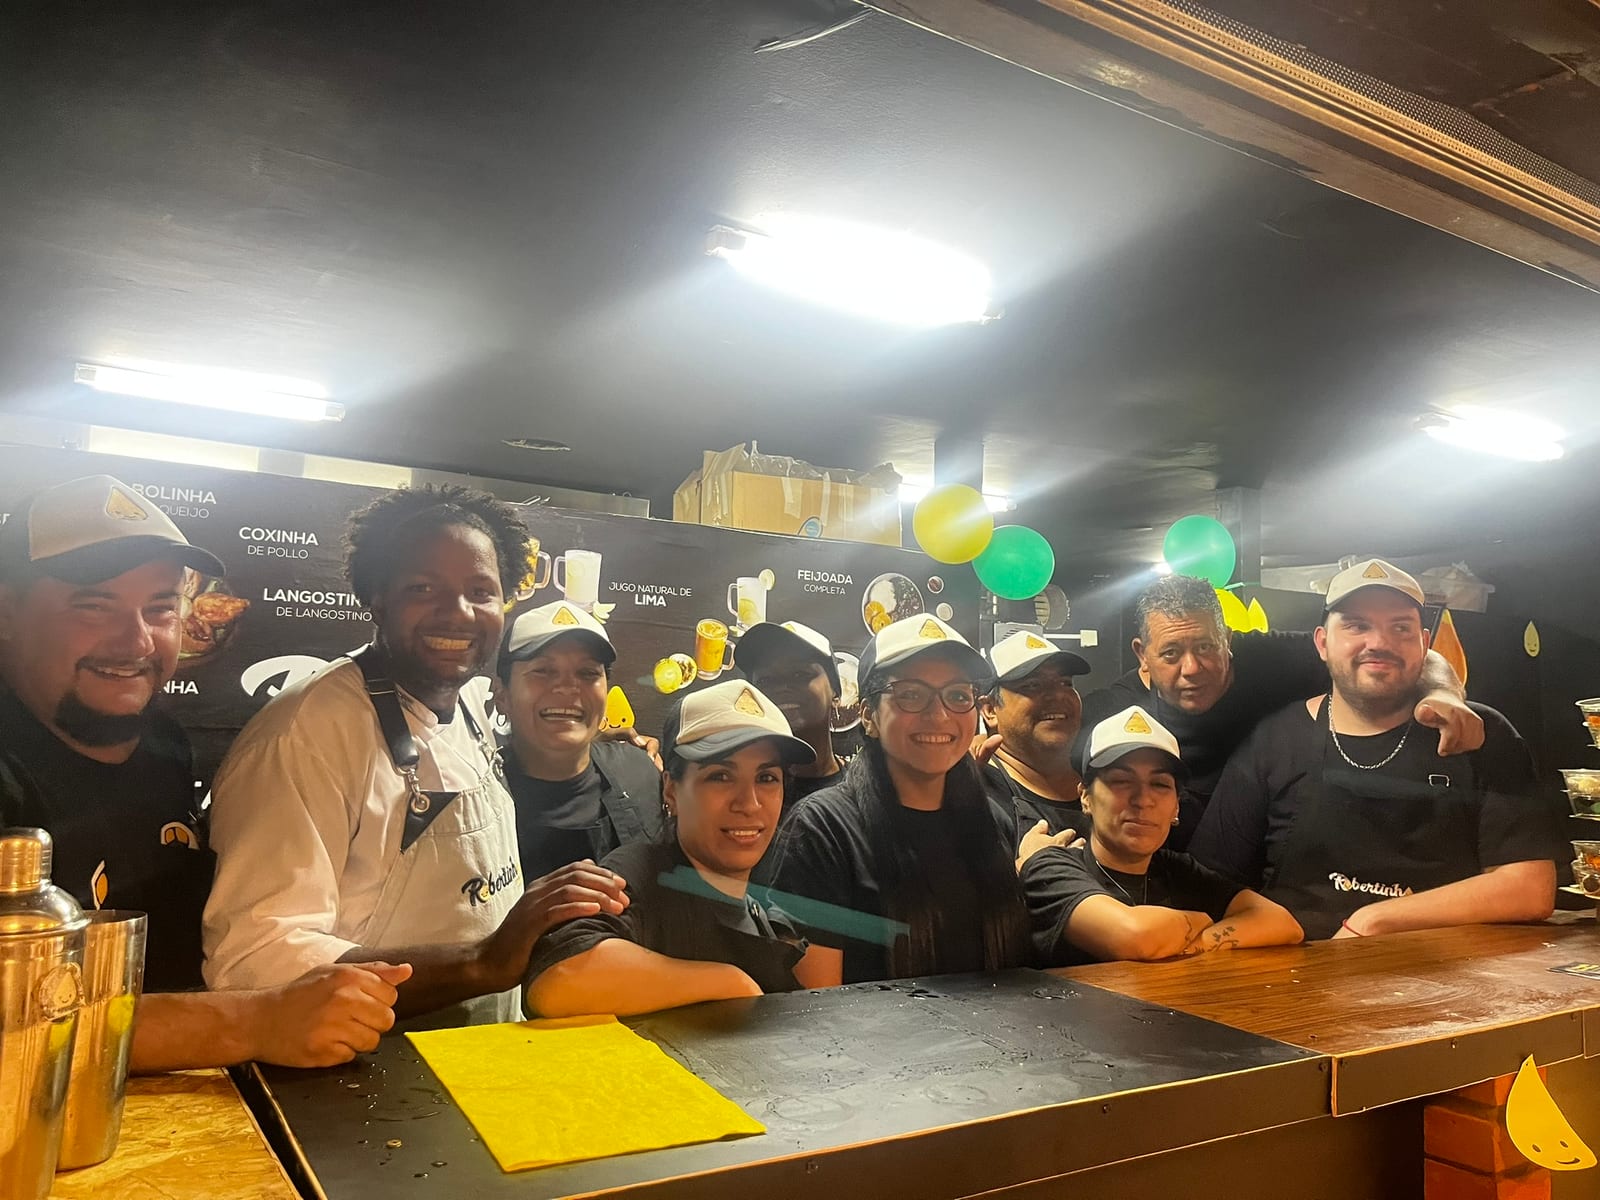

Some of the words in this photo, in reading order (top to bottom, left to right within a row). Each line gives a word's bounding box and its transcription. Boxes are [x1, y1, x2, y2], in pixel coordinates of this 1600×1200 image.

[132, 483, 217, 505] BOLINHA
[160, 504, 210, 519] QUEIJO
[239, 526, 319, 546] COXINHA
[247, 544, 264, 556] DE
[267, 546, 309, 559] POLLO
[797, 569, 853, 585] FEIJOADA
[608, 581, 636, 592] JUGO
[637, 584, 678, 596] NATURAL
[679, 587, 692, 597] DE
[803, 583, 846, 595] COMPLETA
[263, 587, 362, 608] LANGOSTIN
[634, 593, 667, 607] LIMA
[276, 606, 293, 617] DE
[295, 607, 373, 622] LANGOSTINO
